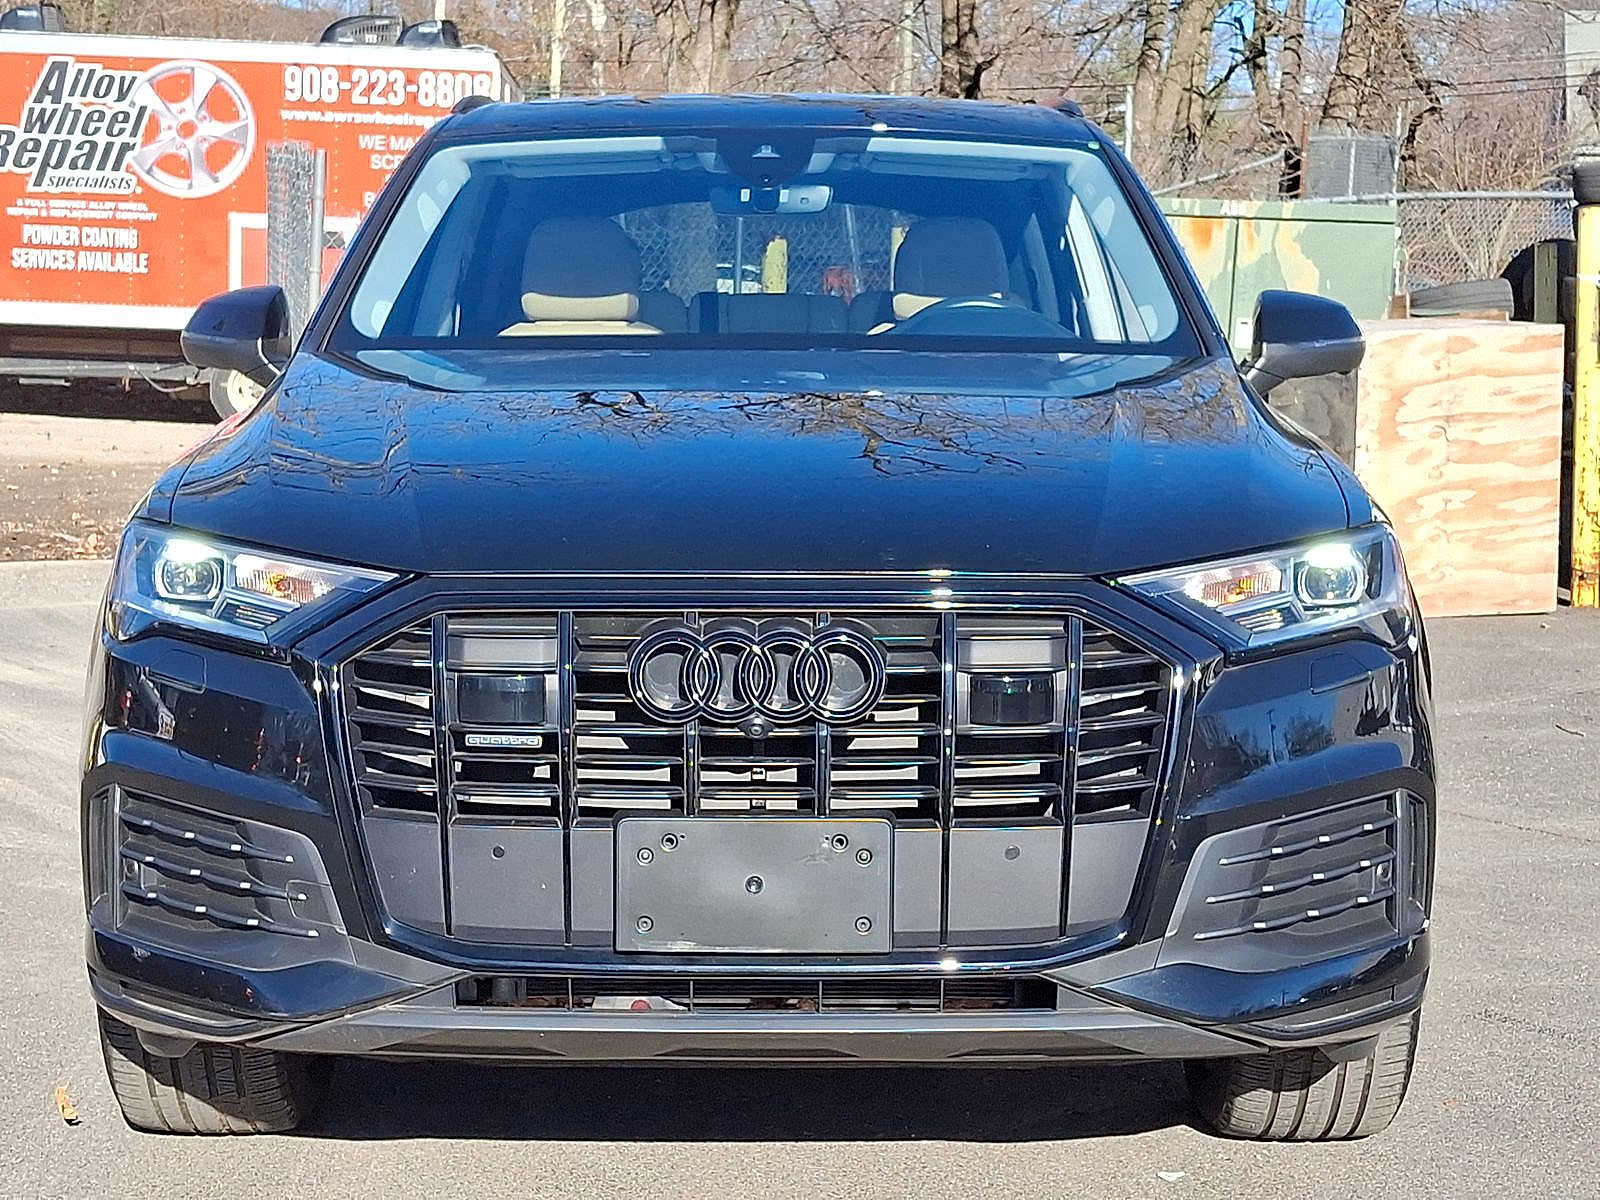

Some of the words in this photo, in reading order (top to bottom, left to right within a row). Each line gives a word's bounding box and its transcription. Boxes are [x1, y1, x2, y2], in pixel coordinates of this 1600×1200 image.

[32, 60, 138, 104] Alloy
[284, 65, 491, 108] 908-223-8808
[23, 102, 148, 138] wheel
[359, 134, 386, 150] WE
[390, 136, 420, 152] MA
[22, 224, 81, 246] POWDER
[81, 226, 139, 250] COATING
[11, 247, 76, 270] SERVICES
[77, 251, 150, 274] AVAILABLE
[467, 735, 541, 747] quattro
